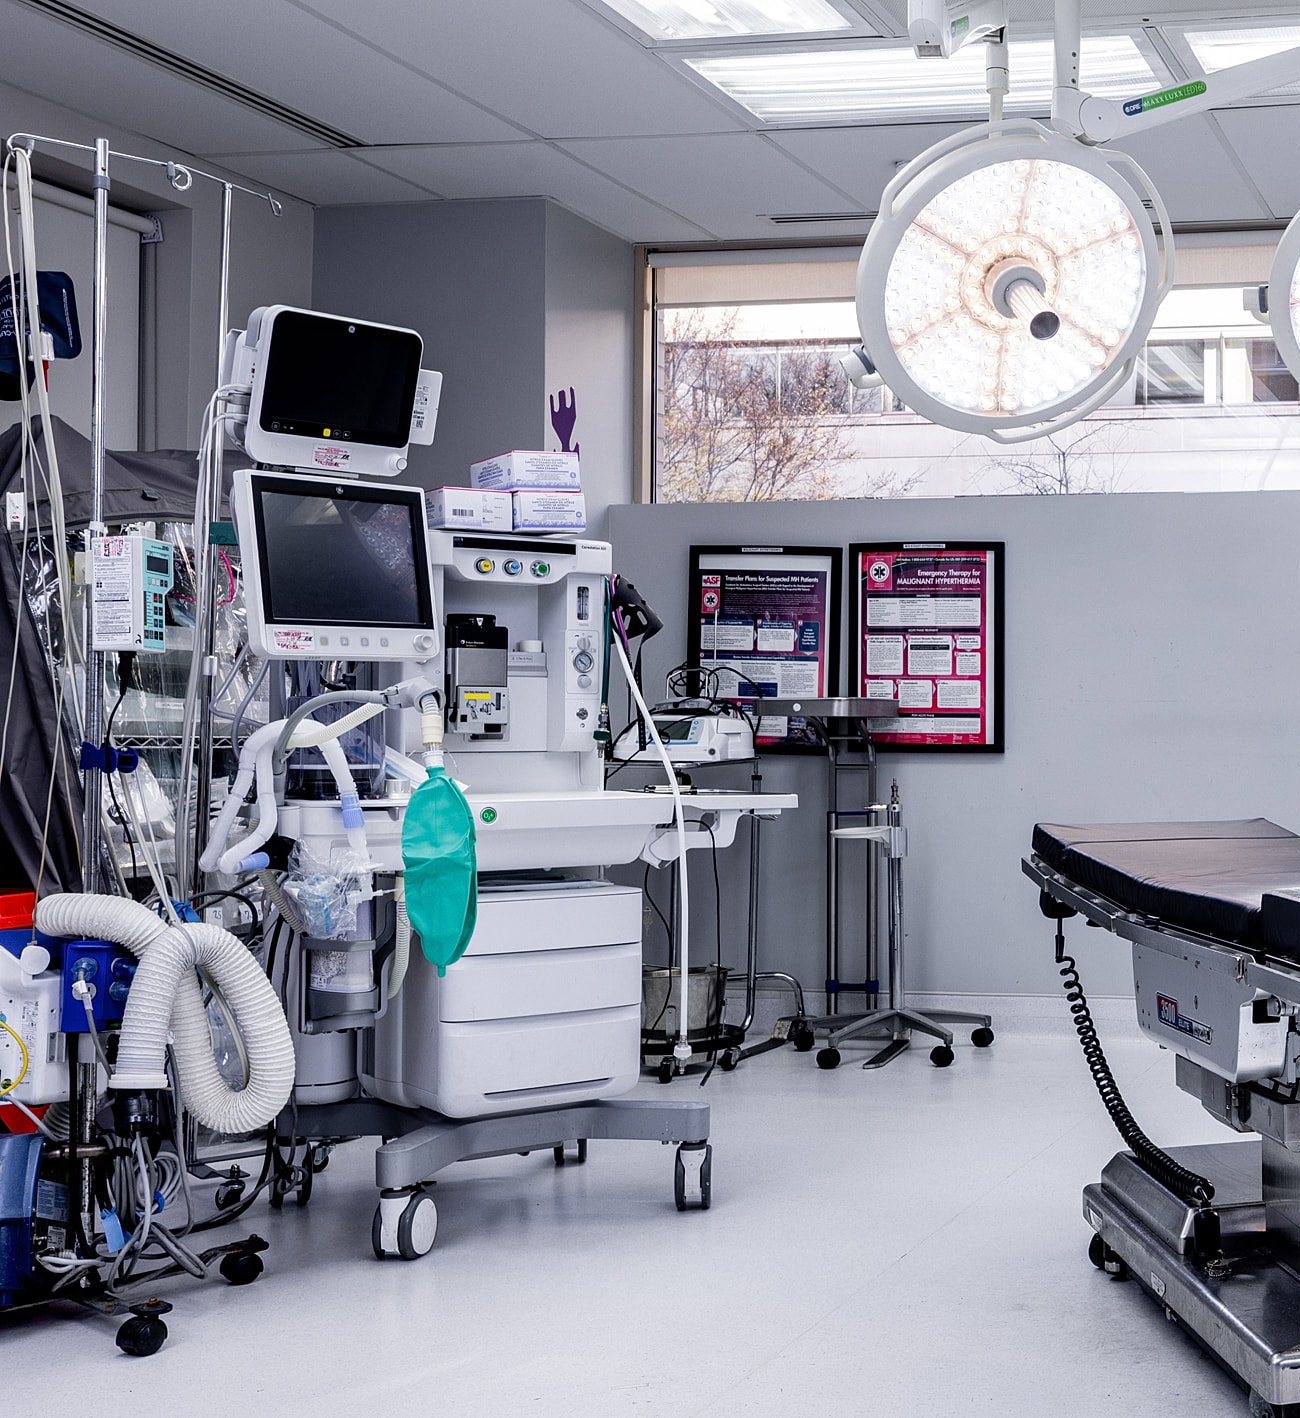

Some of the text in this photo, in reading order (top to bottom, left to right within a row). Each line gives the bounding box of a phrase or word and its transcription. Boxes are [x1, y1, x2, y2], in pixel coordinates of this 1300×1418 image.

[1144, 96, 1164, 107] MAXX
[1165, 90, 1184, 100] LUXX
[918, 569, 948, 577] Emergency
[948, 569, 971, 577] Therapy
